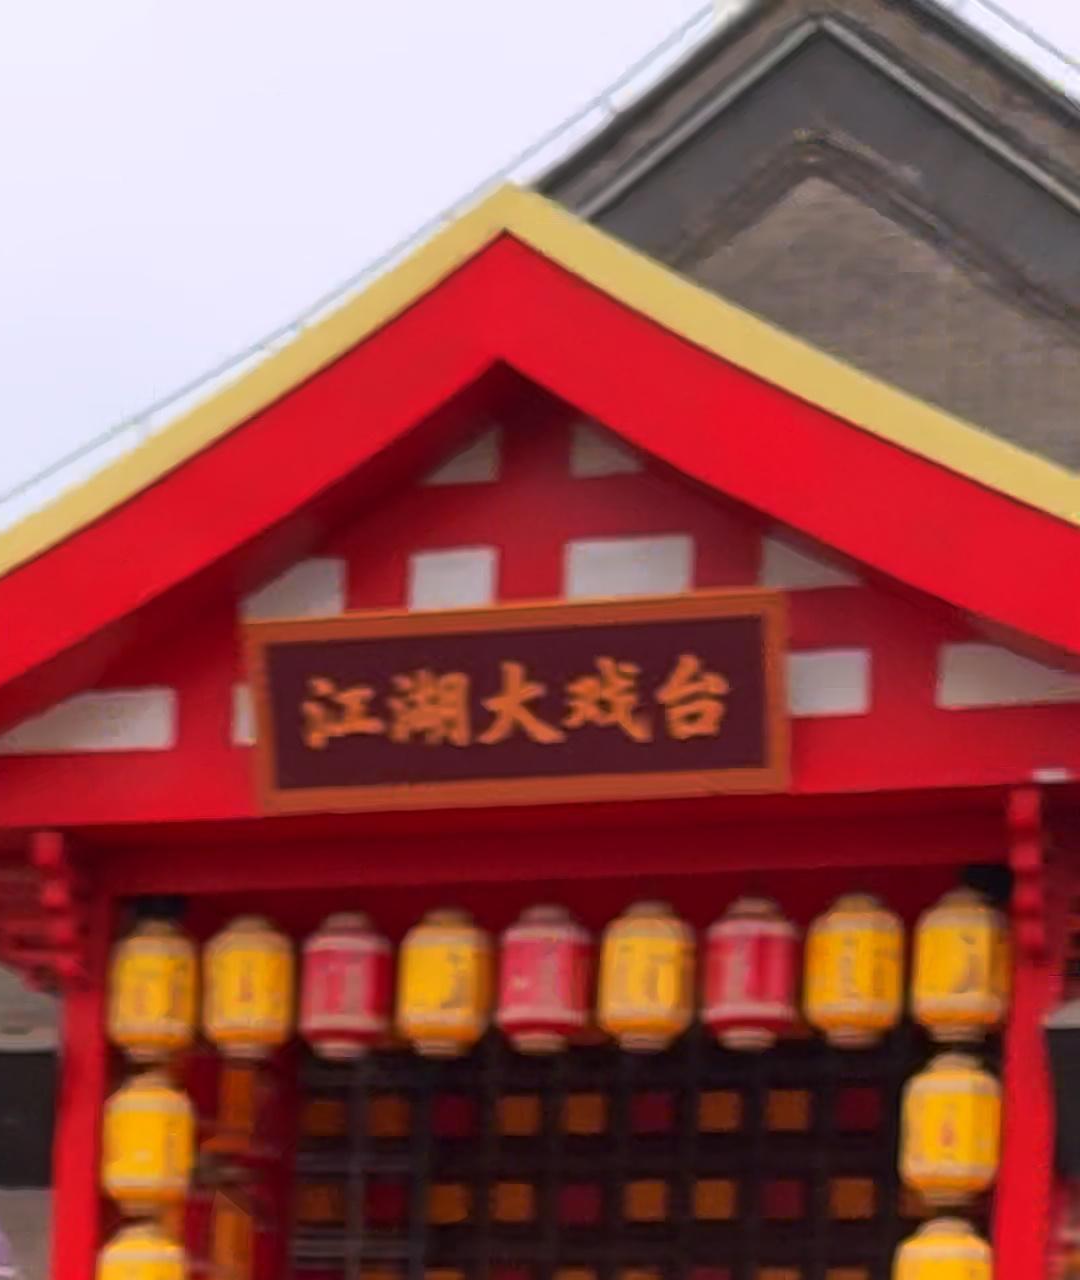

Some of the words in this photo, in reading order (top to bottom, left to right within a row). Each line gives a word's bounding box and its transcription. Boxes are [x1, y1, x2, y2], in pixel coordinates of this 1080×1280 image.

[300, 653, 730, 749] 江湖大戏台
